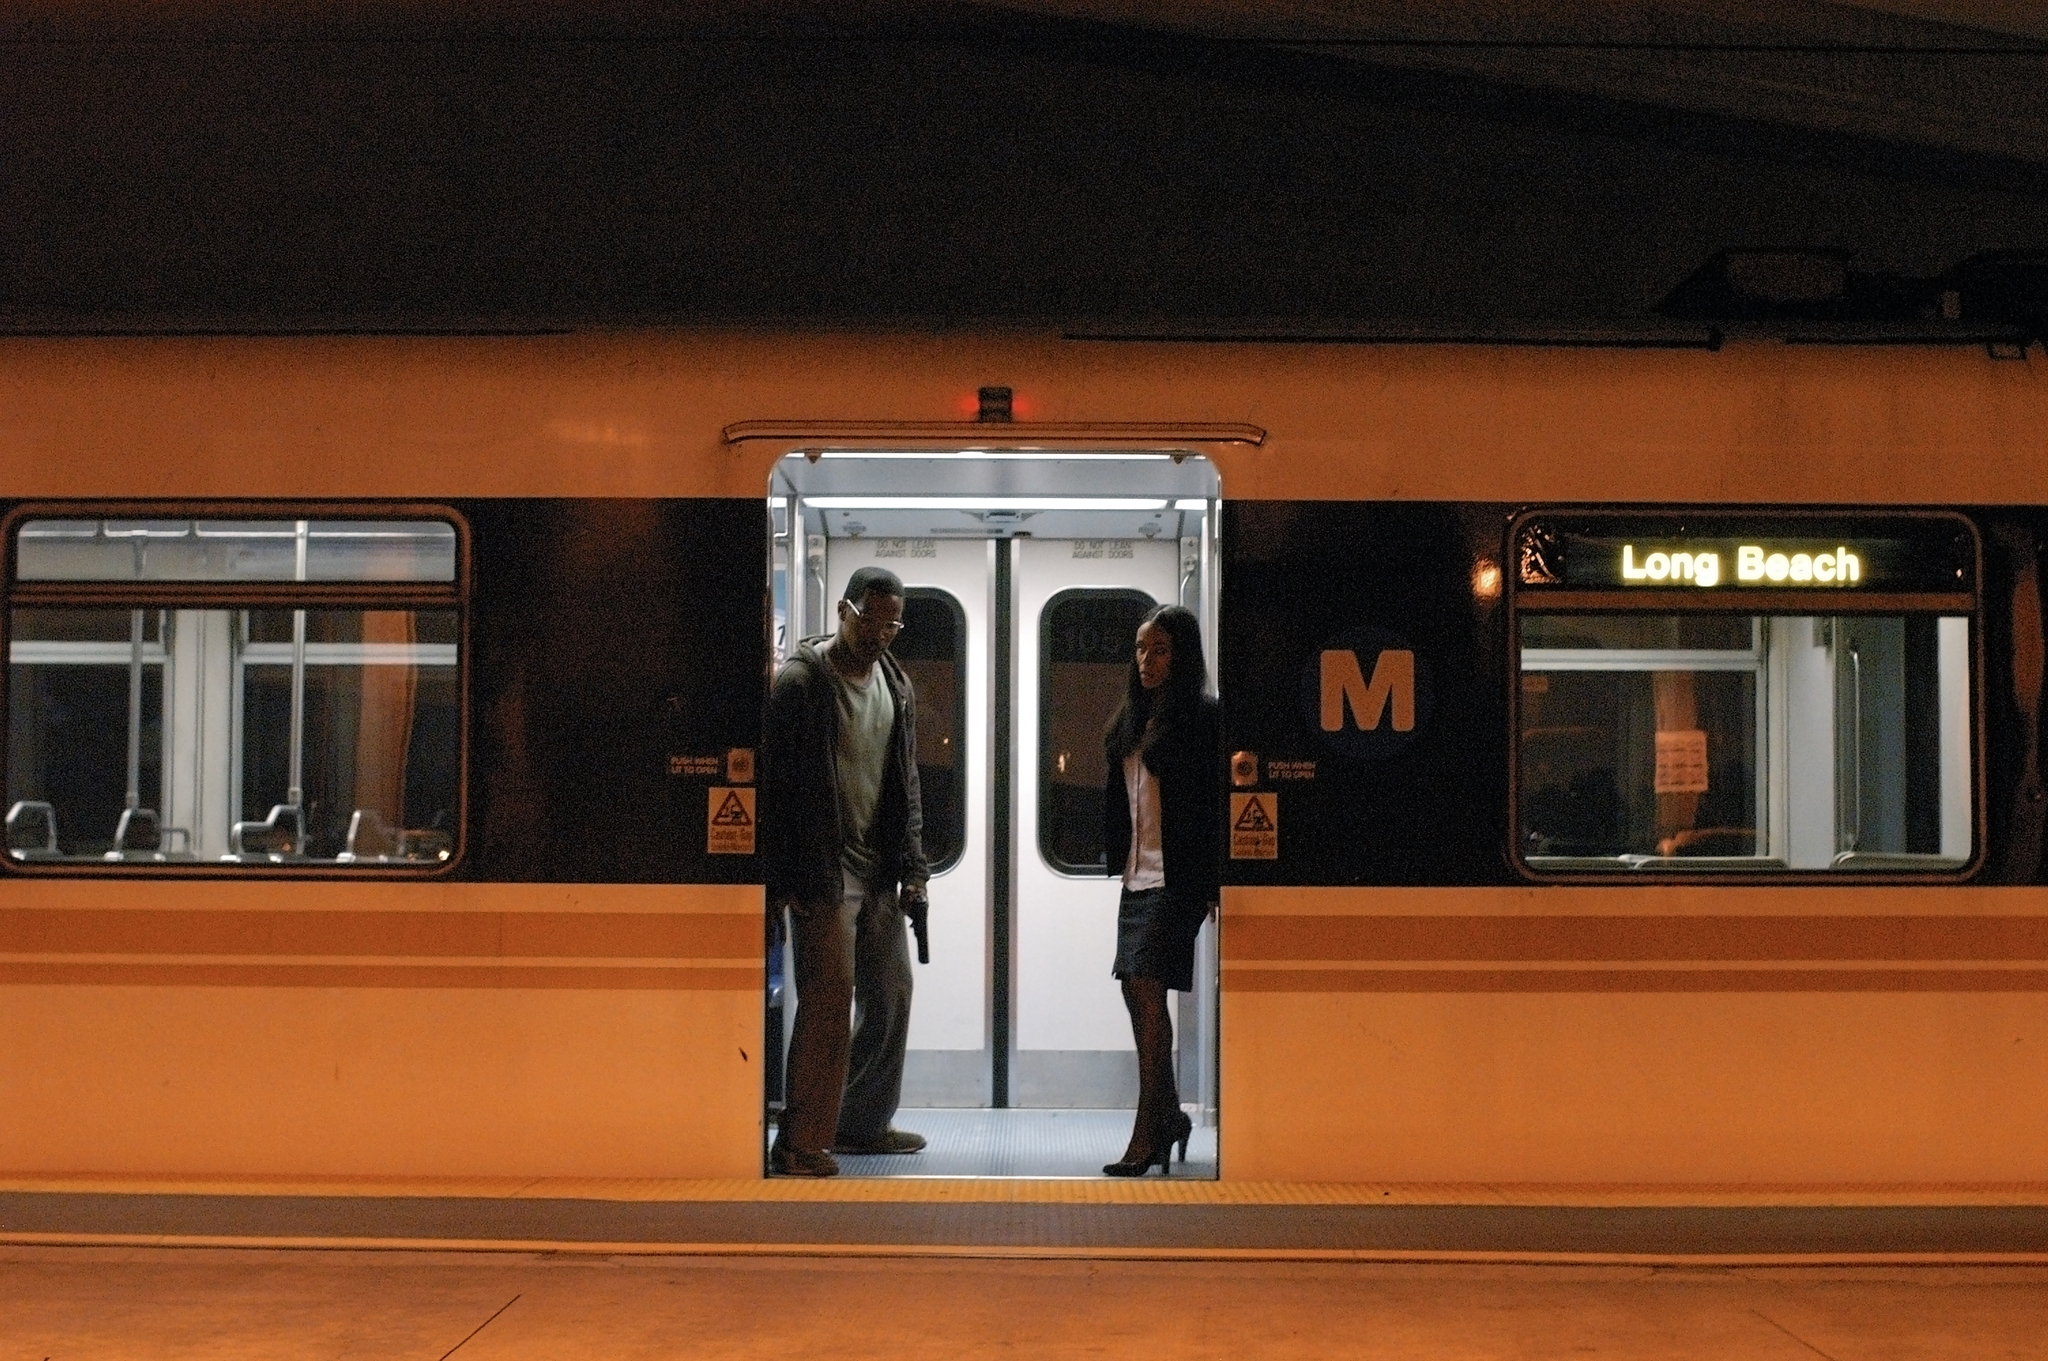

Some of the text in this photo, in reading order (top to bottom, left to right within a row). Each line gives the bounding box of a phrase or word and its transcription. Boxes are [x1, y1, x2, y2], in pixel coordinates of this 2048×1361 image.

[1623, 545, 1860, 587] Long Beach
[1321, 649, 1414, 731] M
[1267, 761, 1316, 769] PUSH WHEN
